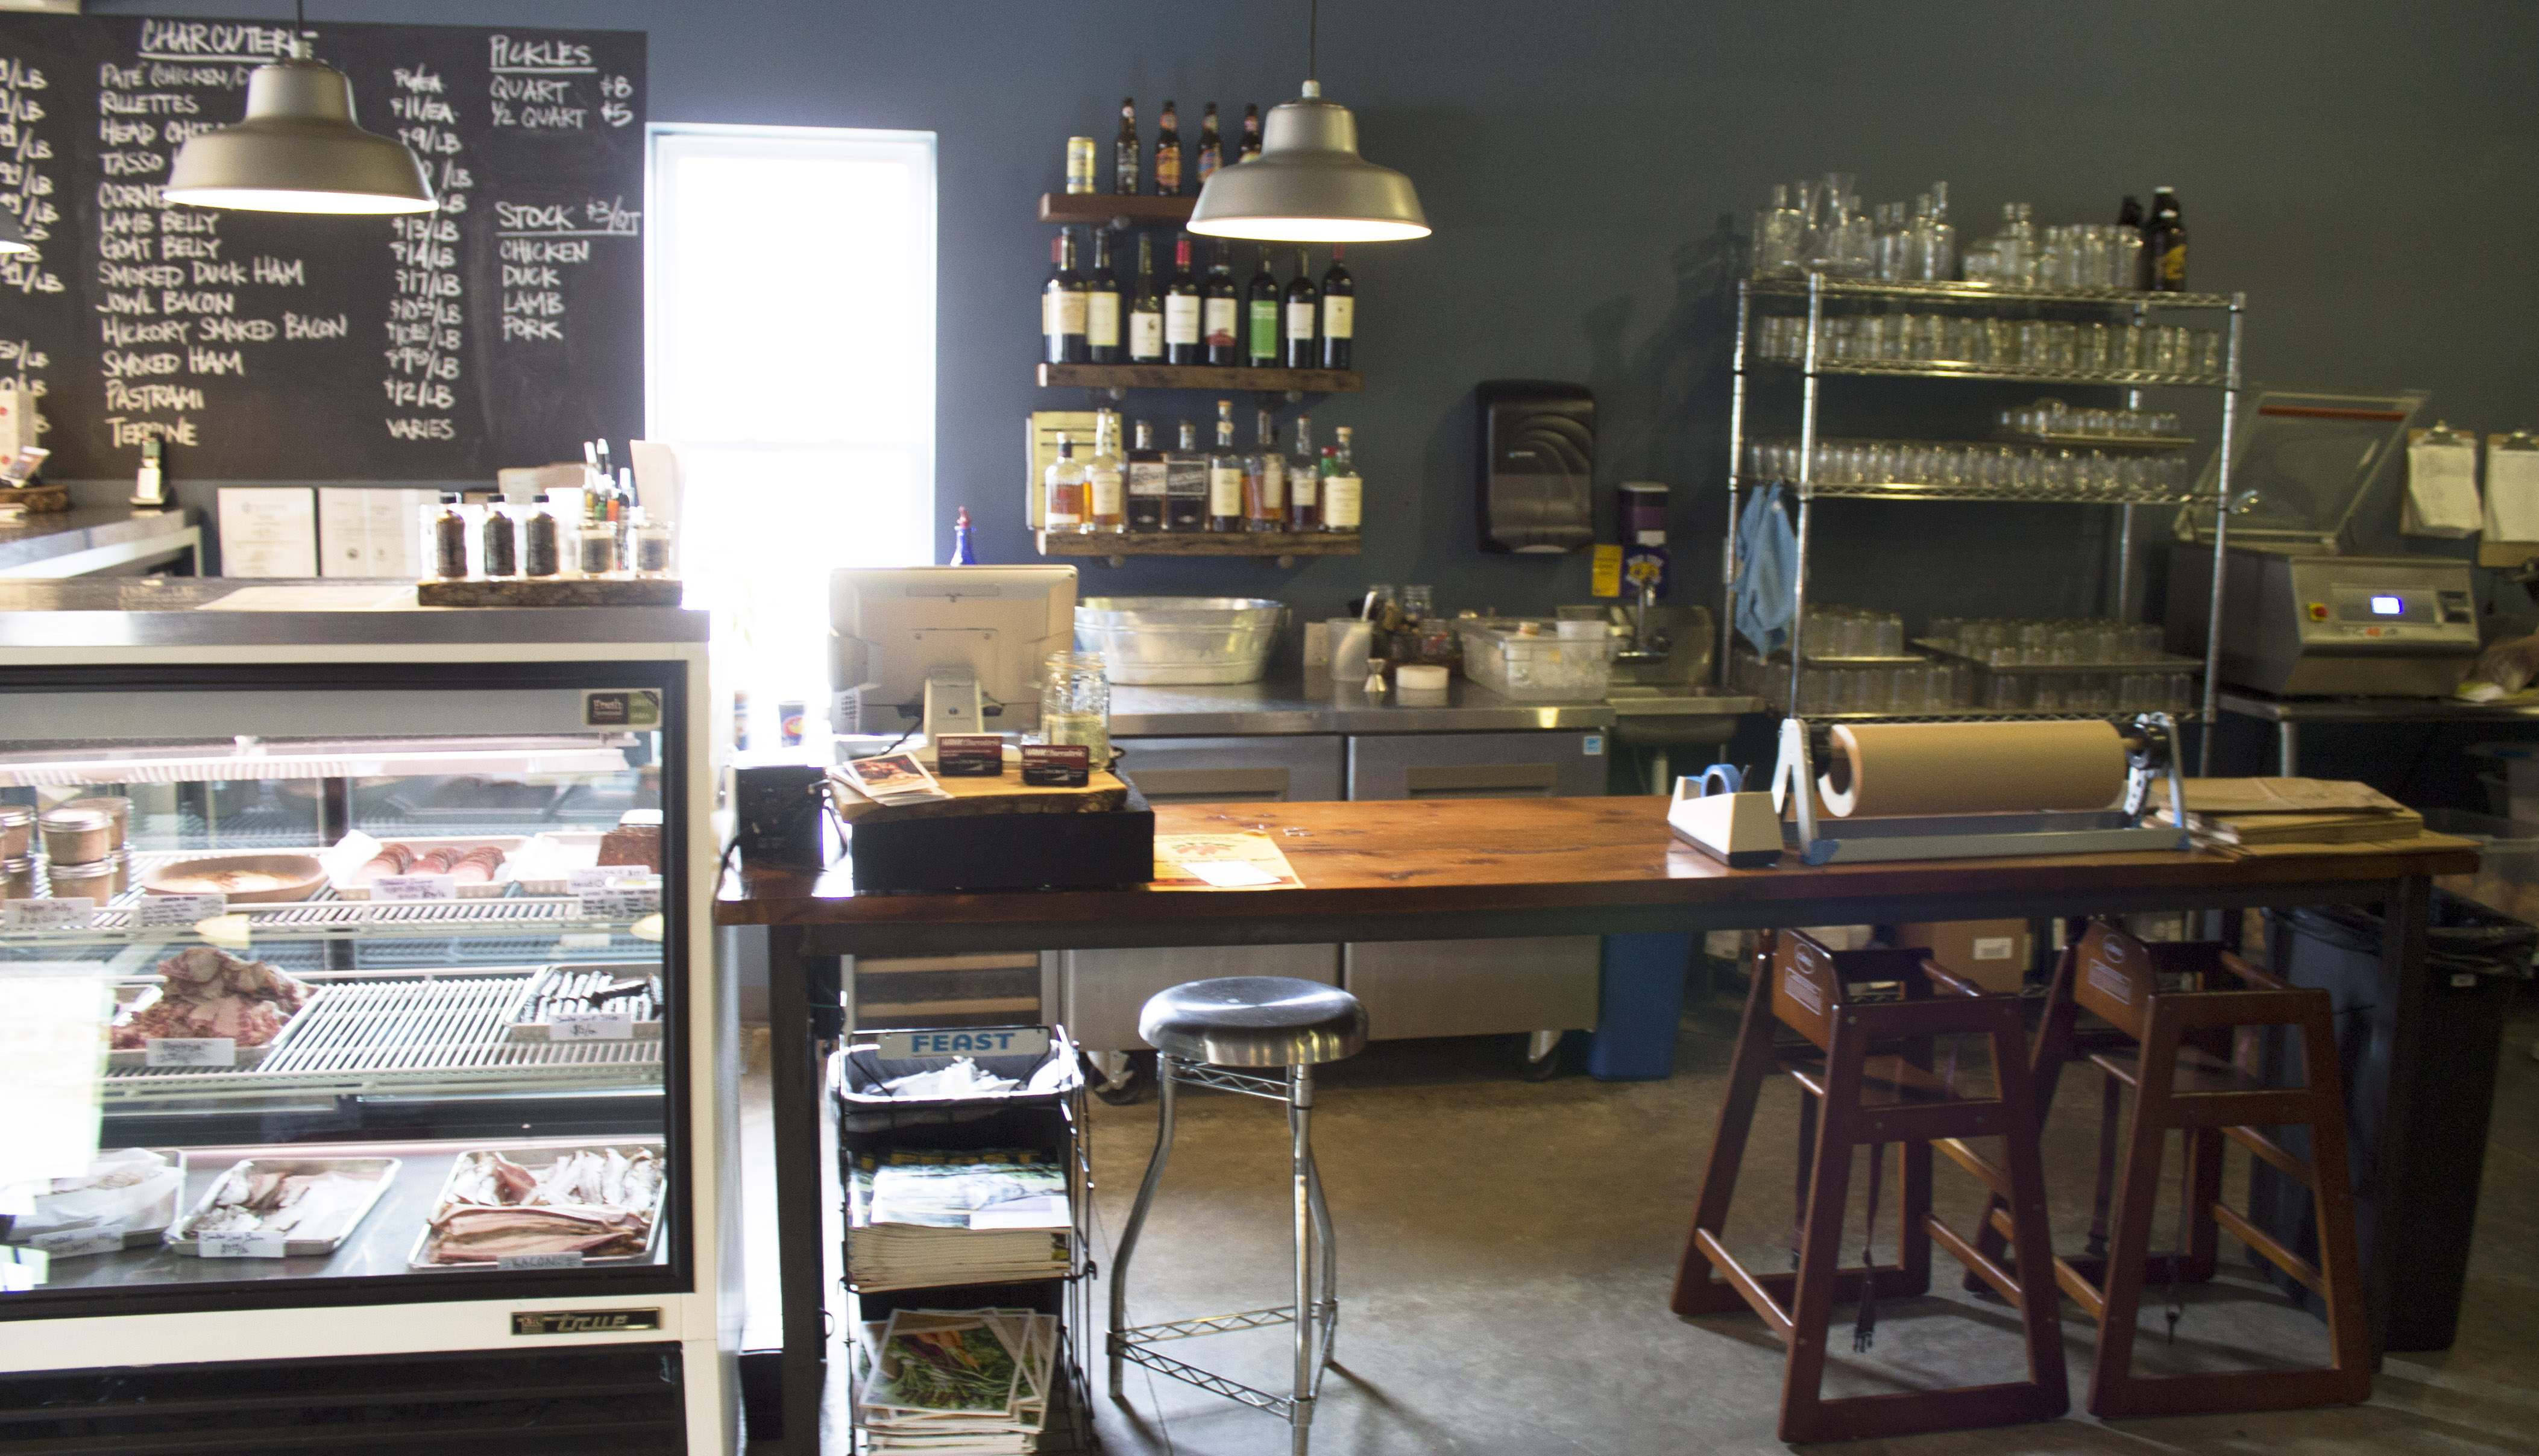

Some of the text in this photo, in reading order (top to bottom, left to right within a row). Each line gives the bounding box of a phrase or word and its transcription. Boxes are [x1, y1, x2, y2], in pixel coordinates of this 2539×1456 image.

[489, 34, 593, 66] PICKLES
[99, 90, 200, 115] RILLETTES
[490, 75, 634, 104] QUART $8
[521, 107, 588, 130] QUART
[600, 102, 635, 127] $5
[99, 119, 158, 146] HEAD
[98, 151, 165, 175] TASSO
[98, 181, 176, 210] CORNE
[160, 210, 220, 234] BELLY
[391, 215, 460, 242] $13/LB
[494, 201, 576, 231] STOCK
[99, 233, 222, 260] GOAT BELLY
[499, 240, 590, 264] CHICKEN
[98, 256, 305, 287] SMOKED DUCK HAM
[502, 265, 561, 288] DUCK
[95, 290, 234, 315] JOWL BACON
[503, 292, 565, 316] LAMB
[101, 310, 348, 347] HICKORY SMOKED BACON
[503, 315, 564, 342] PORK
[102, 345, 245, 377] SMOKED HAM
[105, 380, 206, 412] PASTRAMI
[385, 418, 456, 441] VARIES
[911, 1033, 1015, 1052] FEAST
